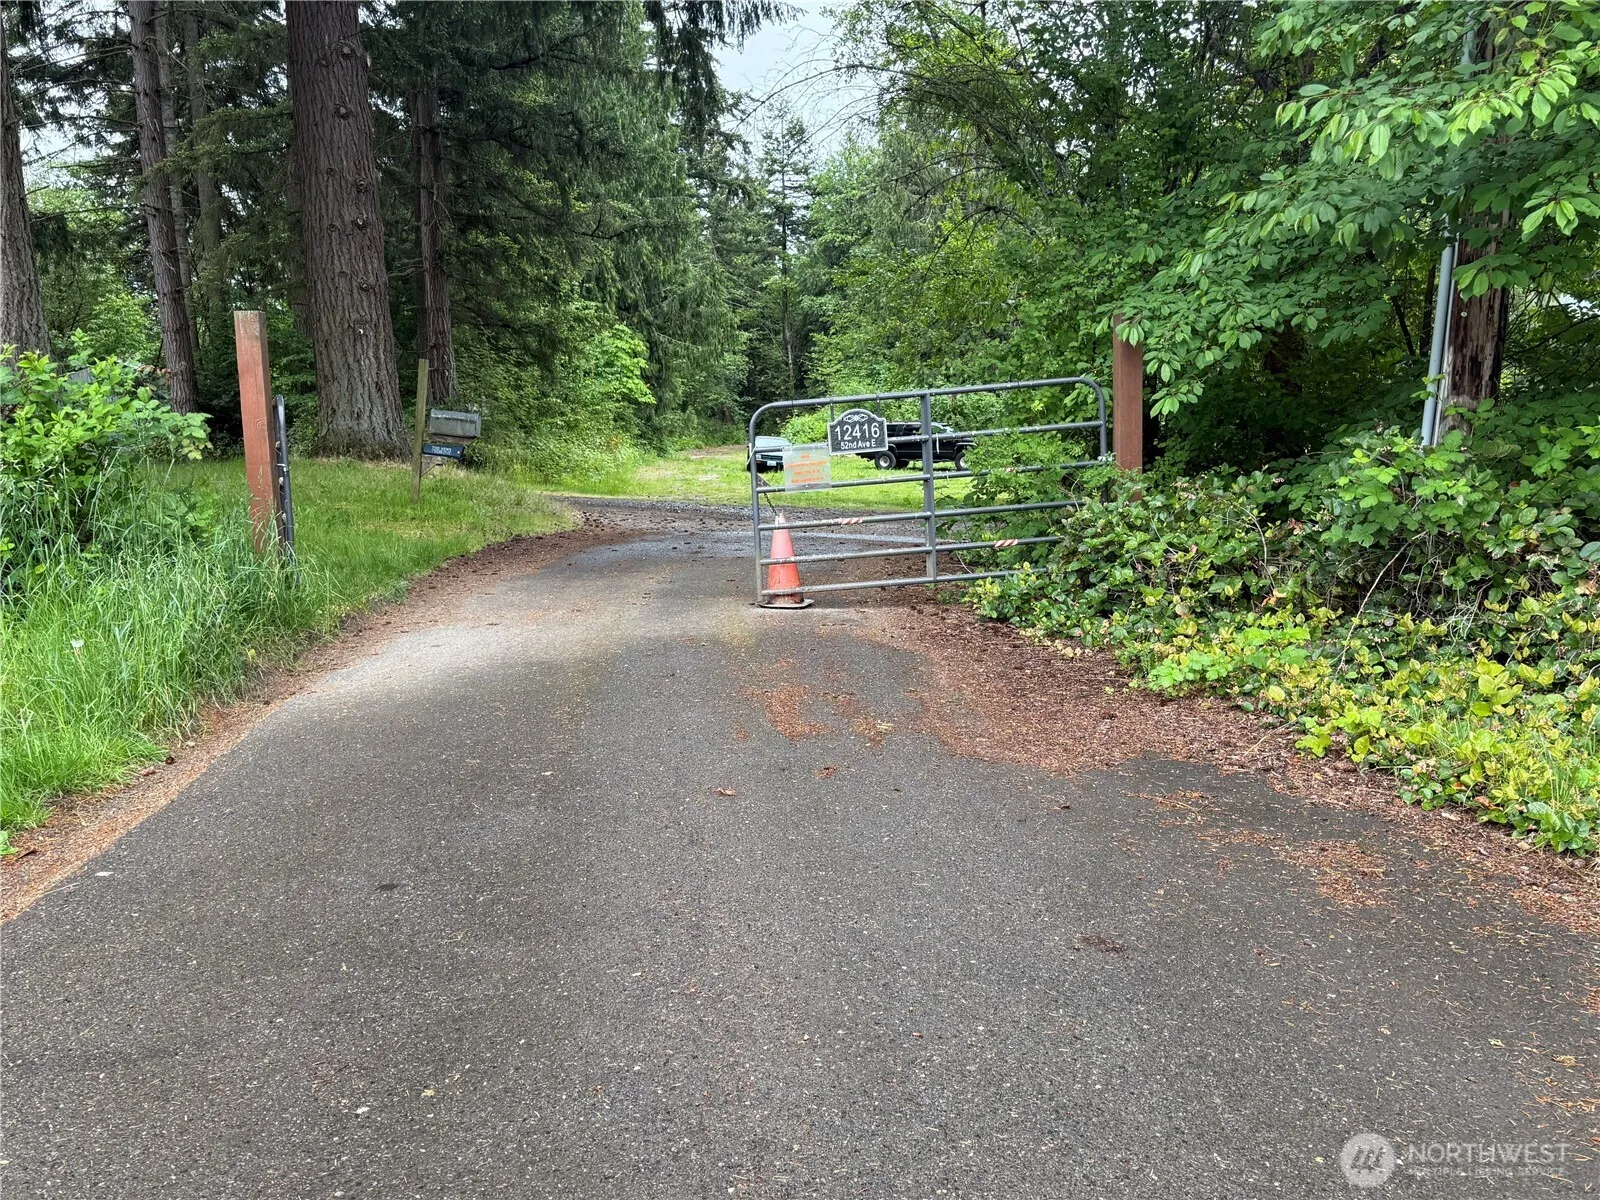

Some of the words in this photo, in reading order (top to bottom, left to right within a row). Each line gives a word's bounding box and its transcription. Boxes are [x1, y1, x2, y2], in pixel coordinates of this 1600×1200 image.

[835, 422, 880, 441] 12416
[840, 441, 857, 450] 52nd
[858, 440, 870, 448] Ave
[871, 439, 876, 447] E
